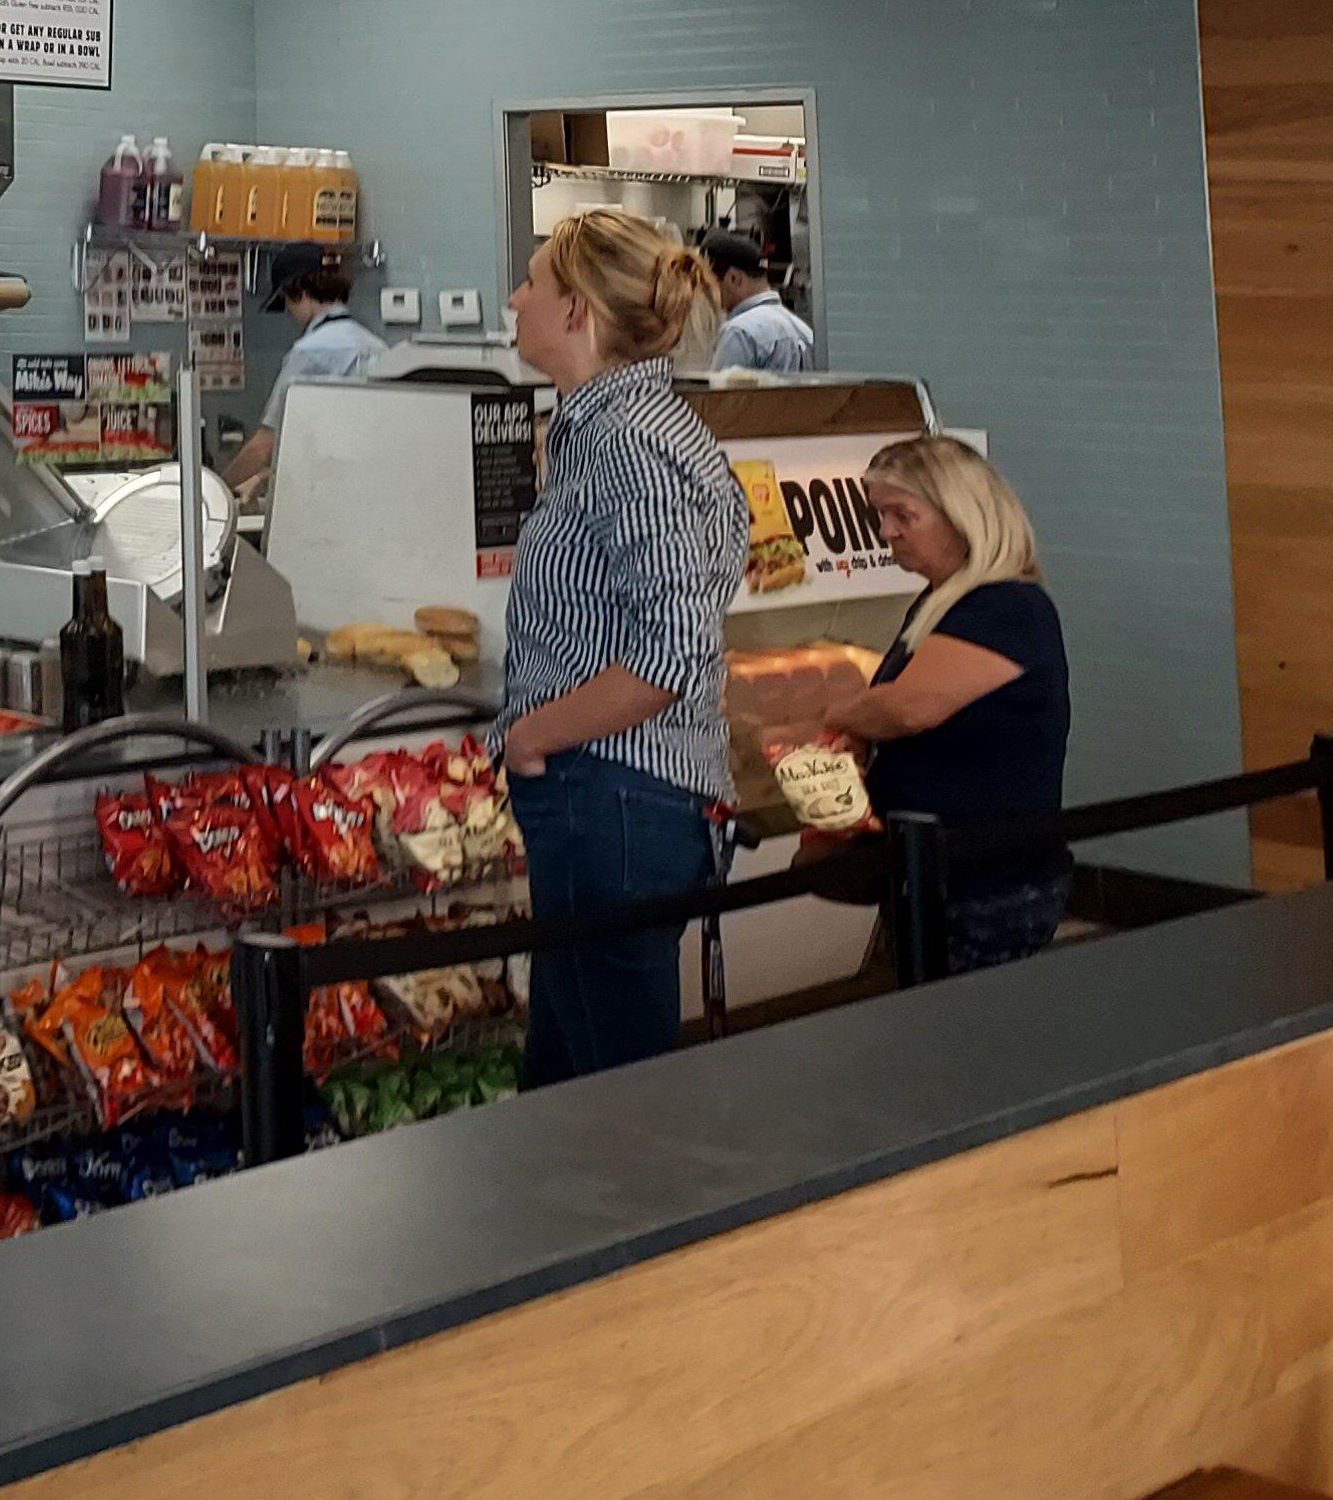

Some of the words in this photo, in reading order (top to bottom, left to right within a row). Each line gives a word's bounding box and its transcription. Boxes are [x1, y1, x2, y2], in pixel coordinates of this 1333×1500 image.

[10, 24, 24, 35] GET
[28, 25, 44, 37] ANY
[48, 27, 83, 40] REGULAR
[86, 30, 101, 41] SUB
[54, 369, 83, 397] Way
[15, 411, 50, 431] SPICES
[474, 403, 501, 422] OUR
[505, 401, 528, 421] APP
[780, 477, 888, 556] POIN
